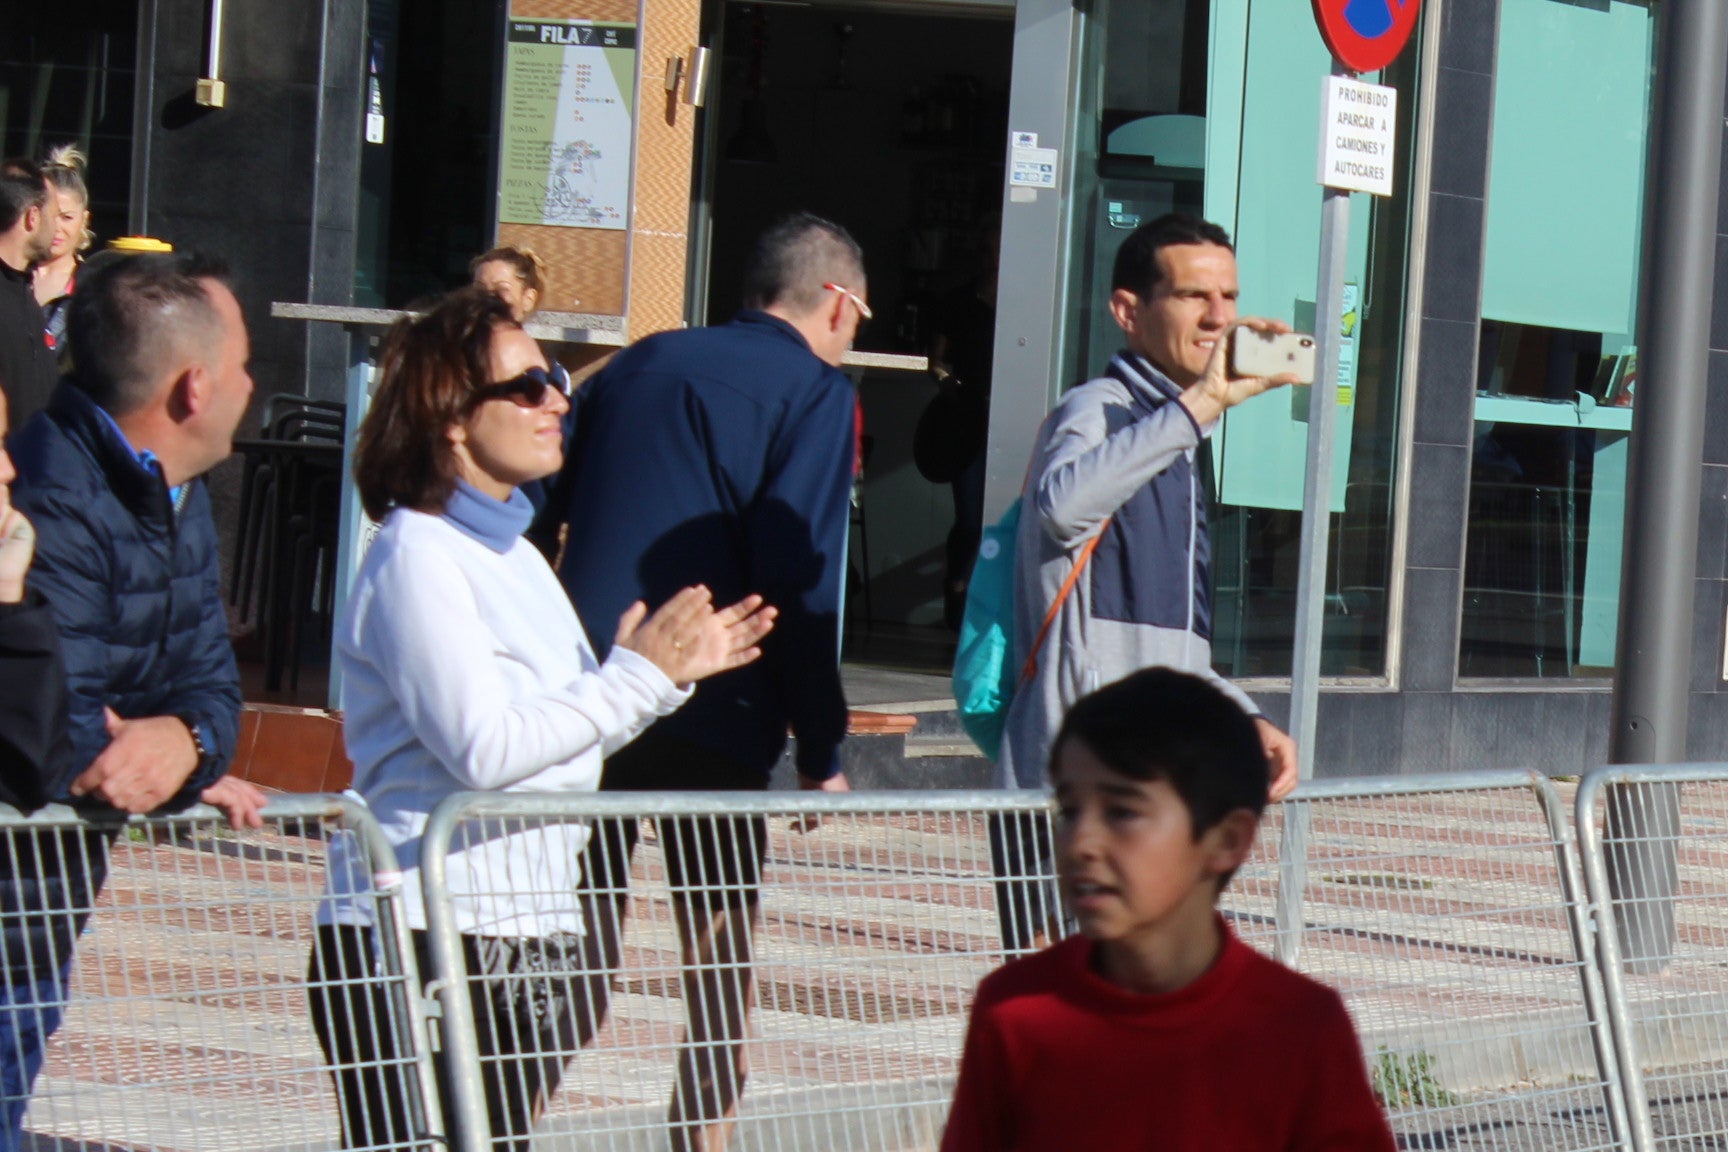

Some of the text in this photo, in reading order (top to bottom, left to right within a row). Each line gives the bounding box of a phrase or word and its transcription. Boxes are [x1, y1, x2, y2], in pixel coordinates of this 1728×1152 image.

[1338, 86, 1389, 108] PROHIBIDO
[1337, 111, 1387, 132] APARCAR A
[1335, 135, 1387, 156] CAMIONES Y
[1334, 160, 1385, 180] AUTOCARES
